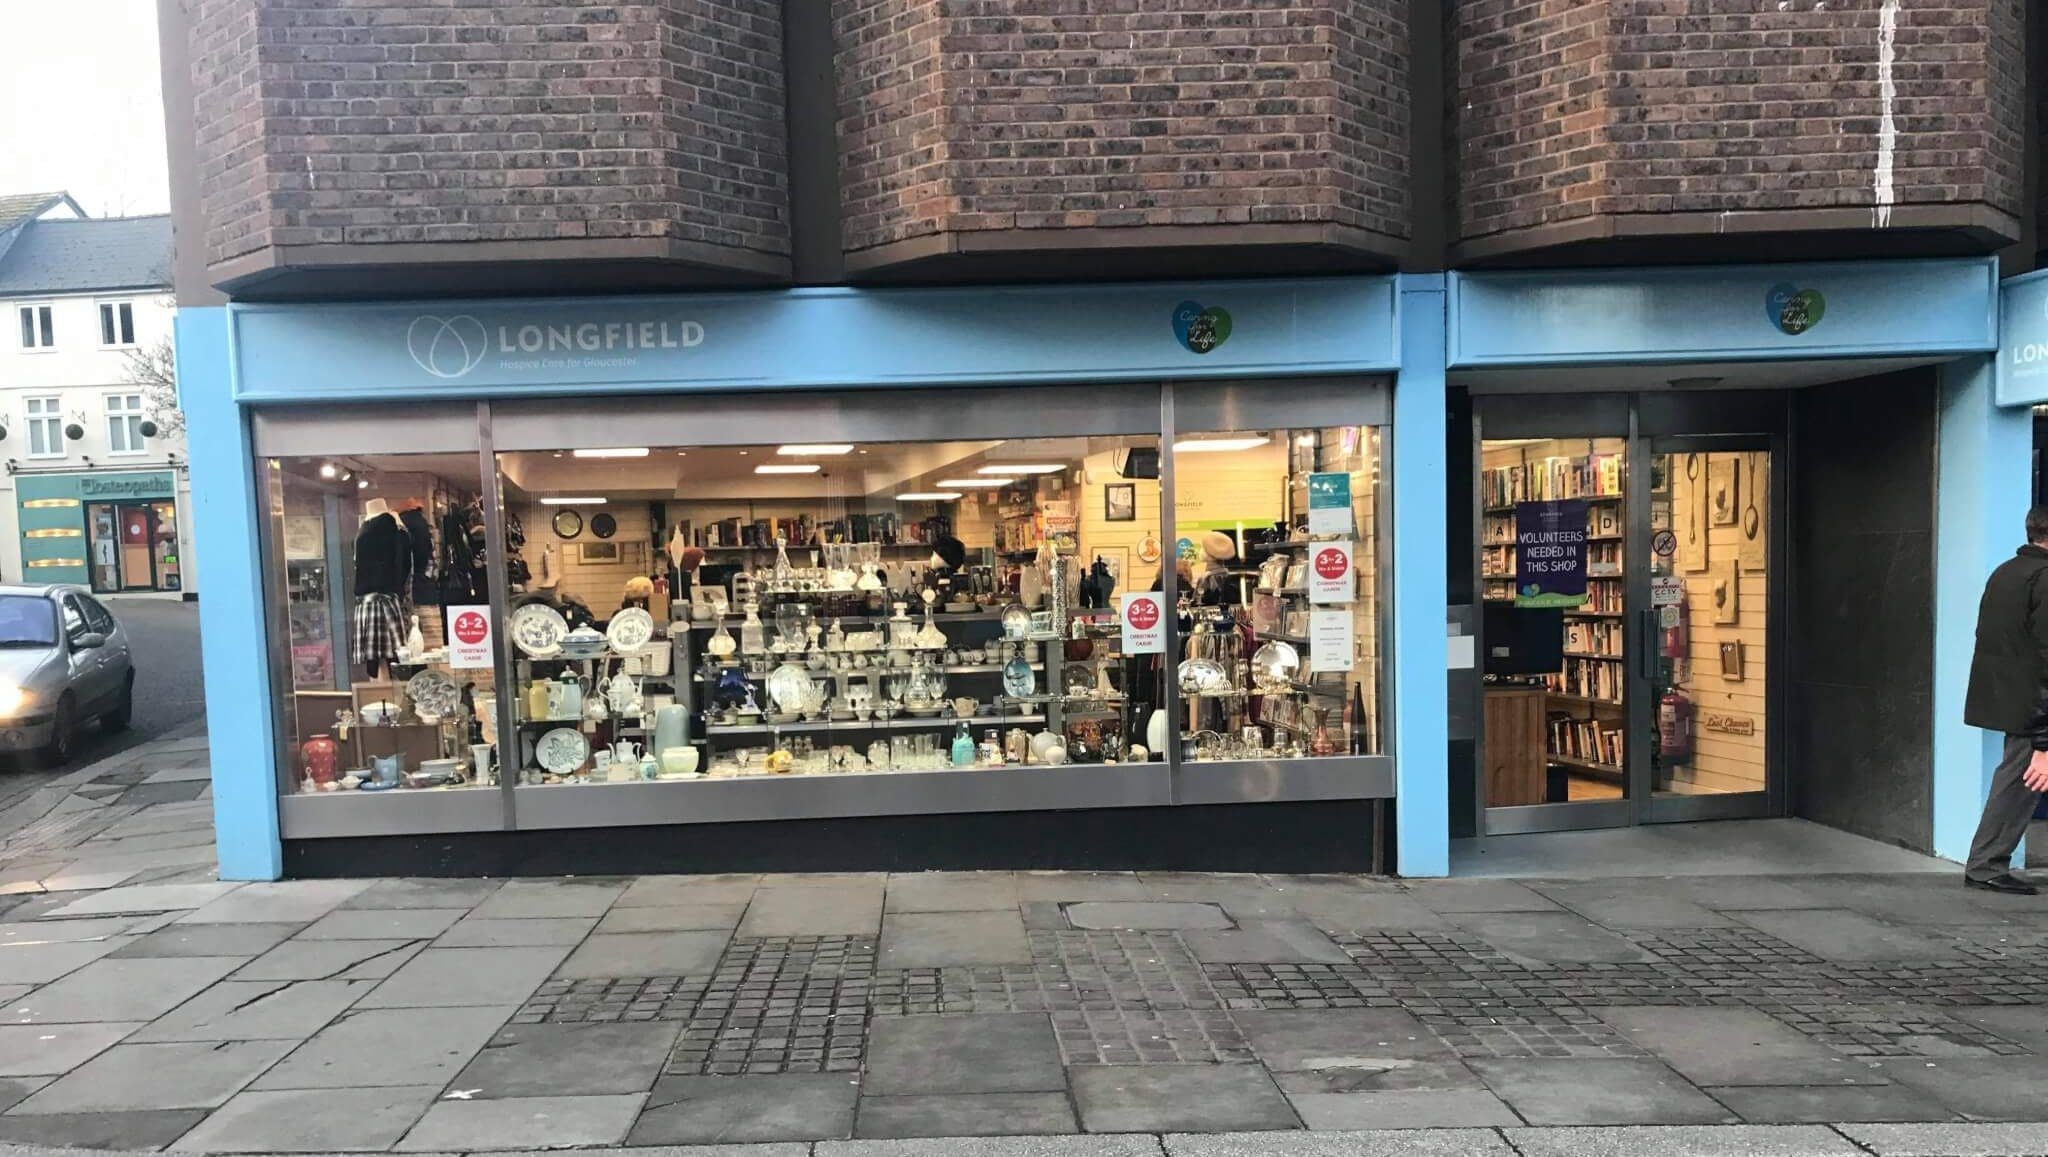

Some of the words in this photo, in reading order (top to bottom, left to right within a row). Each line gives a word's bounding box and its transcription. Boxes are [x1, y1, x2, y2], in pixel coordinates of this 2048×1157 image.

[498, 321, 705, 352] LONGFIELD
[1190, 331, 1216, 349] Life
[567, 358, 581, 368] for
[1603, 518, 1612, 528] D
[1495, 526, 1504, 537] A
[1520, 531, 1583, 544] VOLUNTEERS
[1527, 547, 1564, 558] NEEDED
[1567, 545, 1576, 557] IN
[1526, 561, 1548, 573] THIS
[1551, 560, 1577, 572] SHOP
[1570, 633, 1578, 643] S
